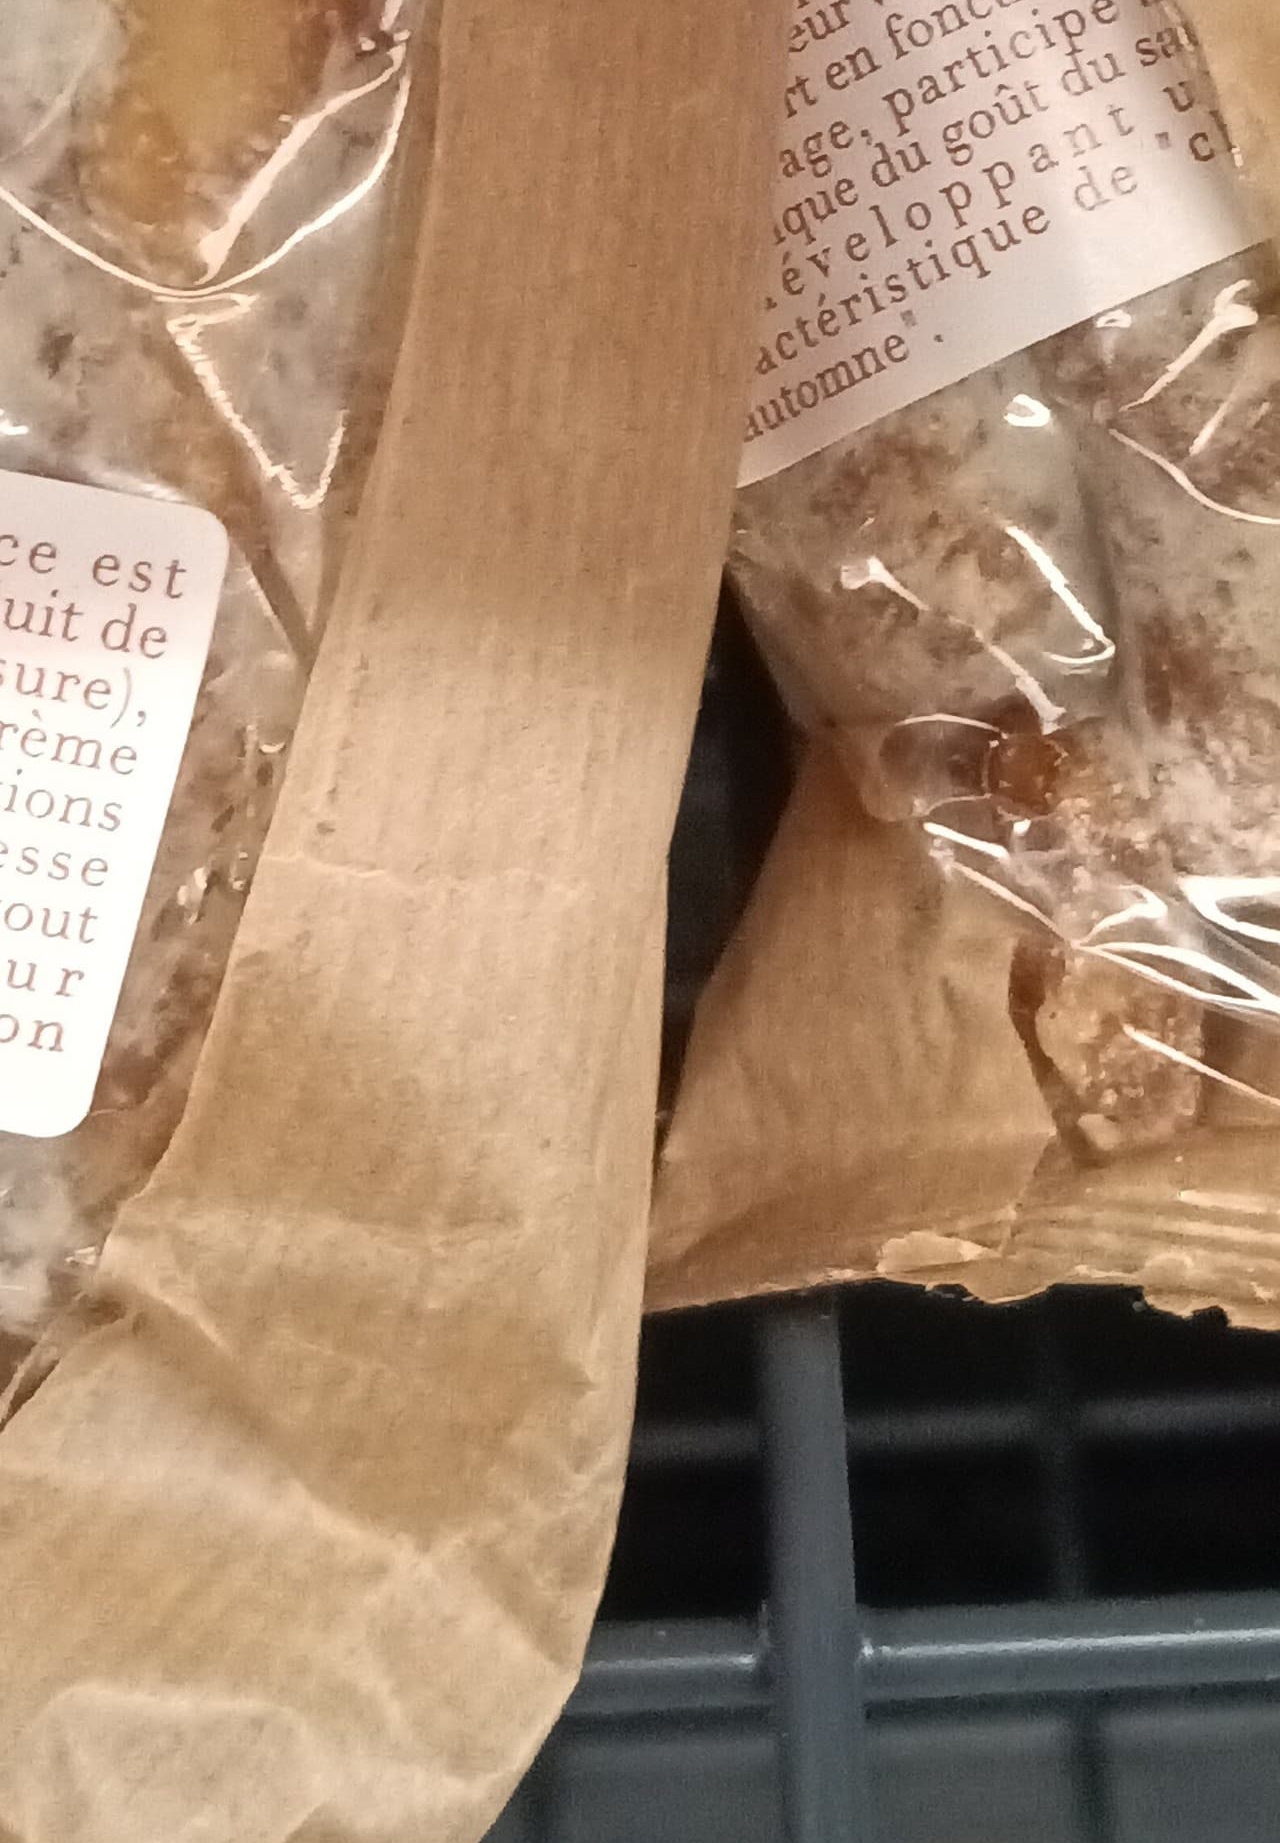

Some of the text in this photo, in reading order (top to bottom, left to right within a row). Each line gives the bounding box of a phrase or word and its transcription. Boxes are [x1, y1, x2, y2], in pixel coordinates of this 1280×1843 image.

[825, 46, 882, 91] en
[871, 139, 931, 188] du
[941, 80, 1049, 167] goût
[1061, 51, 1126, 96] du
[765, 103, 1135, 312] éveloppant
[1073, 164, 1137, 212] de
[92, 553, 187, 599] est
[101, 603, 168, 658] de
